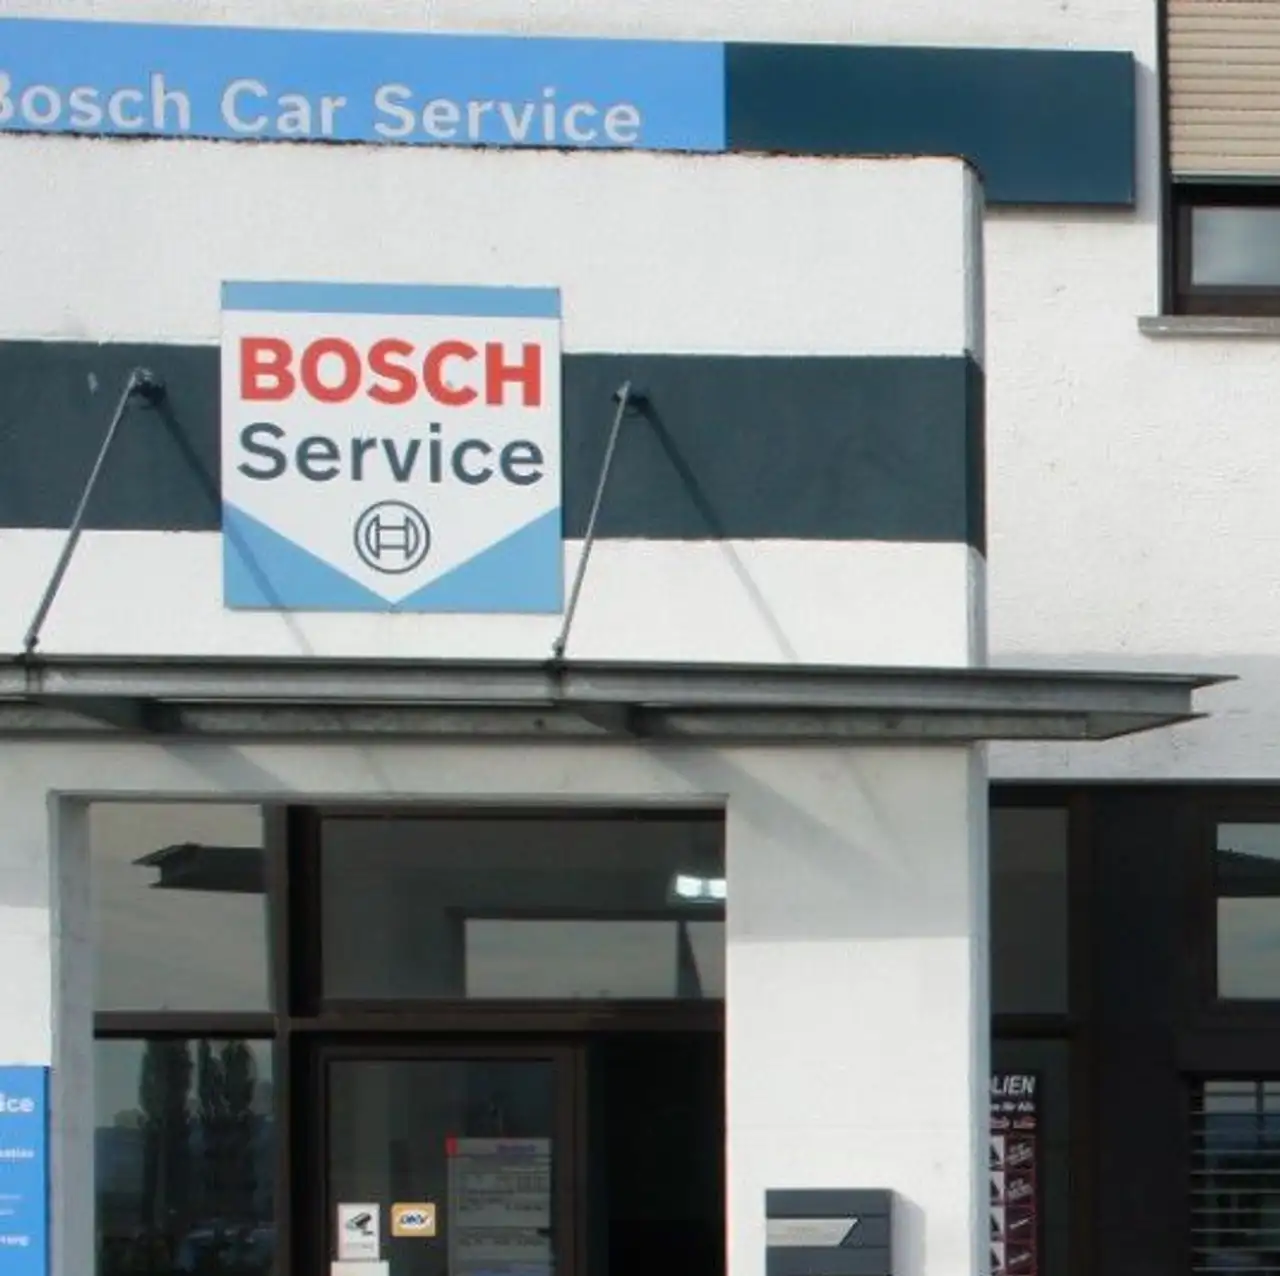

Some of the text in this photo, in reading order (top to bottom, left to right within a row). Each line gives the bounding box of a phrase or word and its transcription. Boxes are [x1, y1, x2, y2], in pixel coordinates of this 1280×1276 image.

[221, 80, 347, 138] Car
[373, 83, 643, 142] Service
[241, 338, 541, 406] BOSCH
[237, 422, 544, 486] Service
